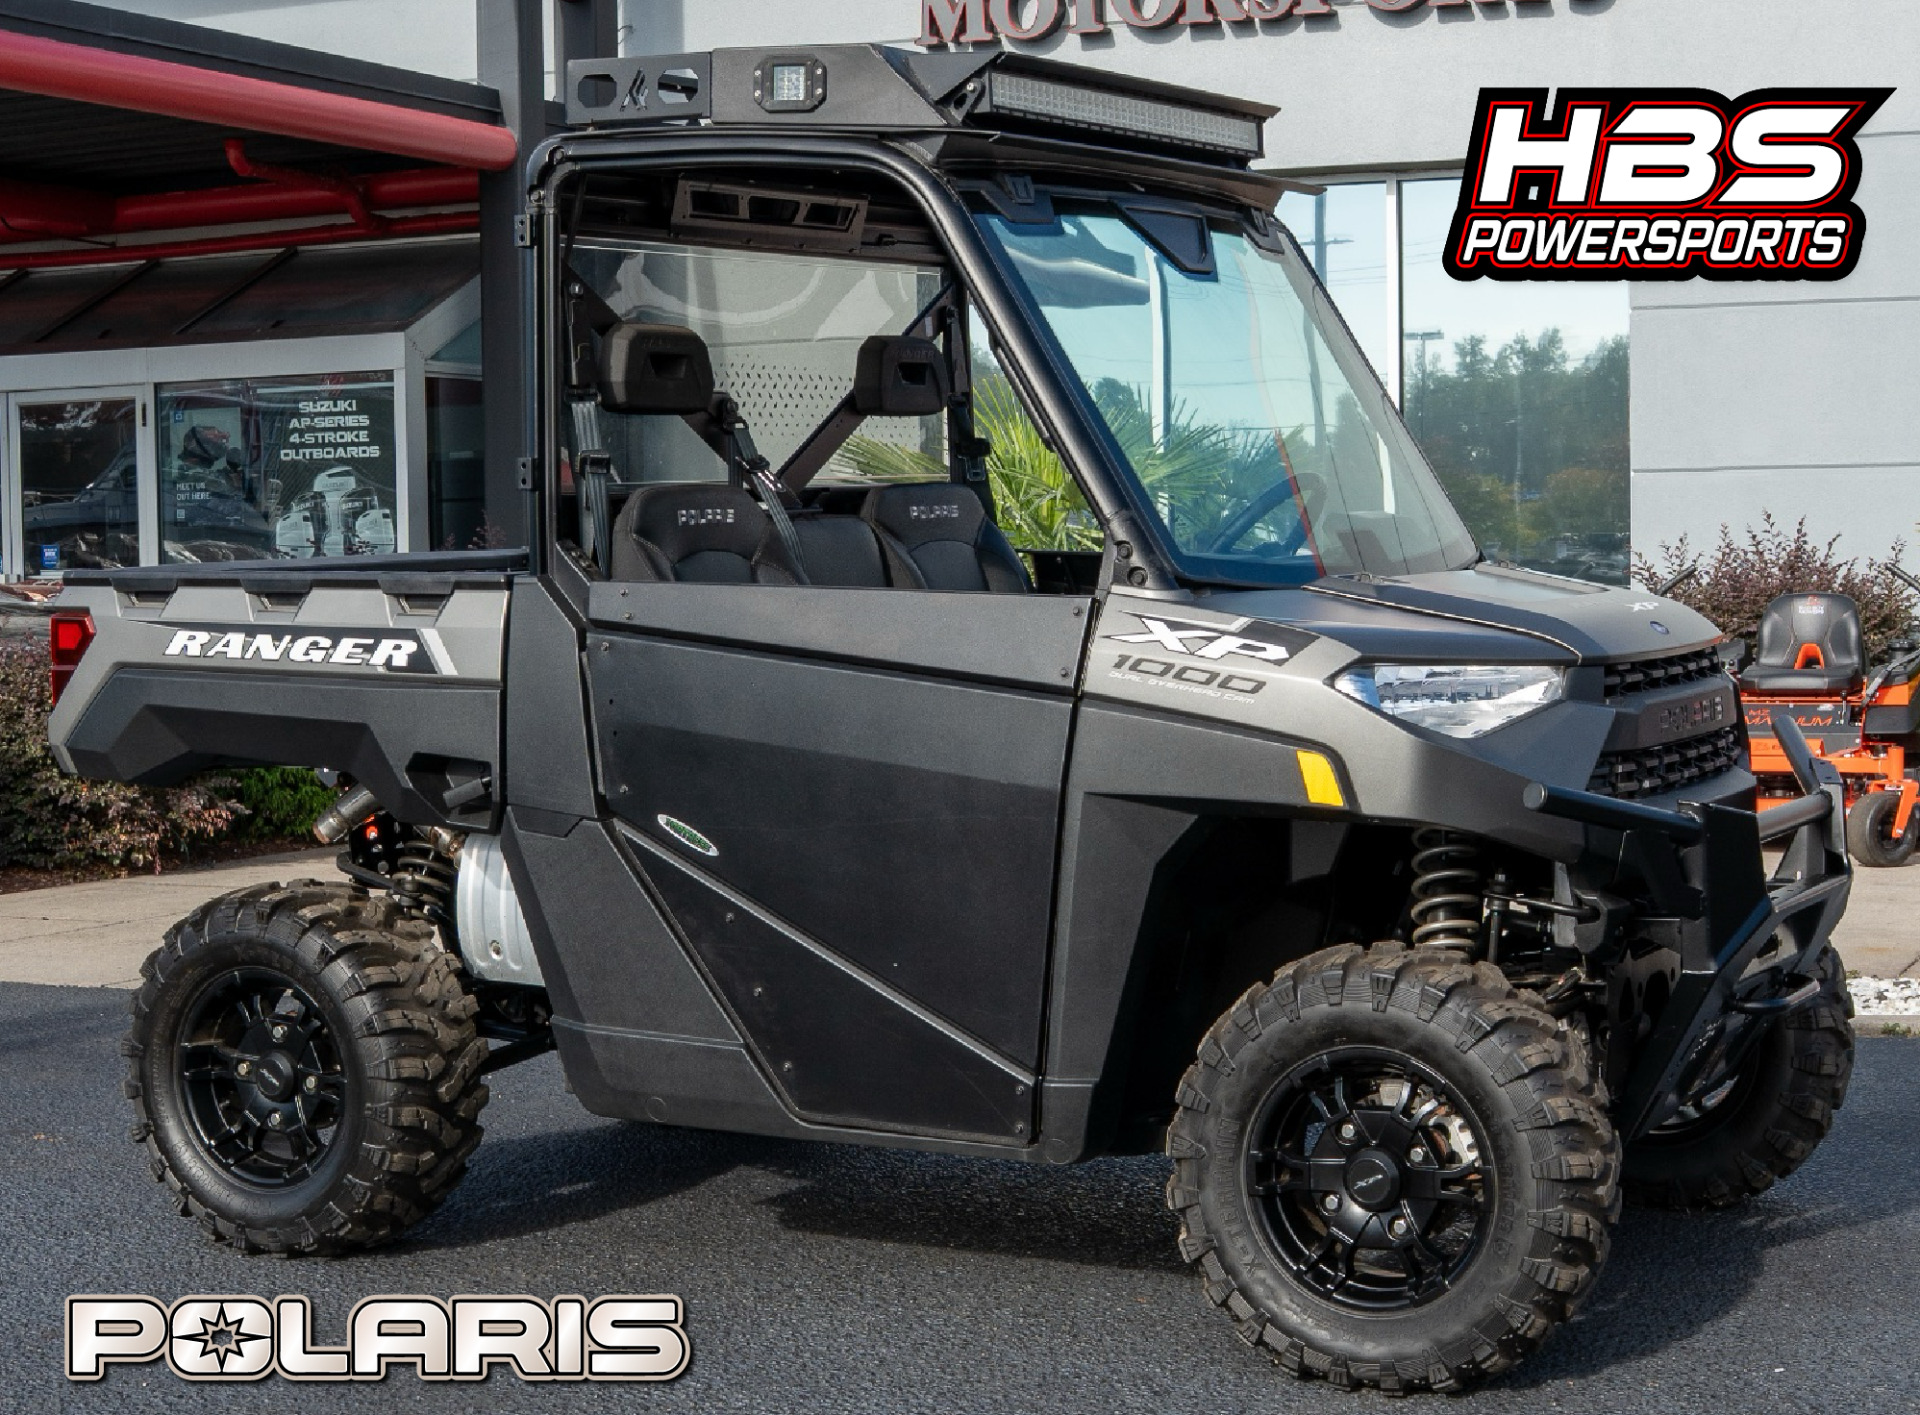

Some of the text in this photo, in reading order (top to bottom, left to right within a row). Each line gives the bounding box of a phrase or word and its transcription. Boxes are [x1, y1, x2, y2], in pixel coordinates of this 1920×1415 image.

[298, 400, 357, 413] SUZUKI
[289, 431, 370, 444] 4-STROKE
[280, 445, 380, 461] OUTBOARDS
[1103, 616, 1290, 660] XP
[163, 629, 418, 667] RANGER
[1108, 670, 1143, 683] DUAL
[1112, 653, 1267, 695] 1000
[1744, 715, 1833, 727] MAUM
